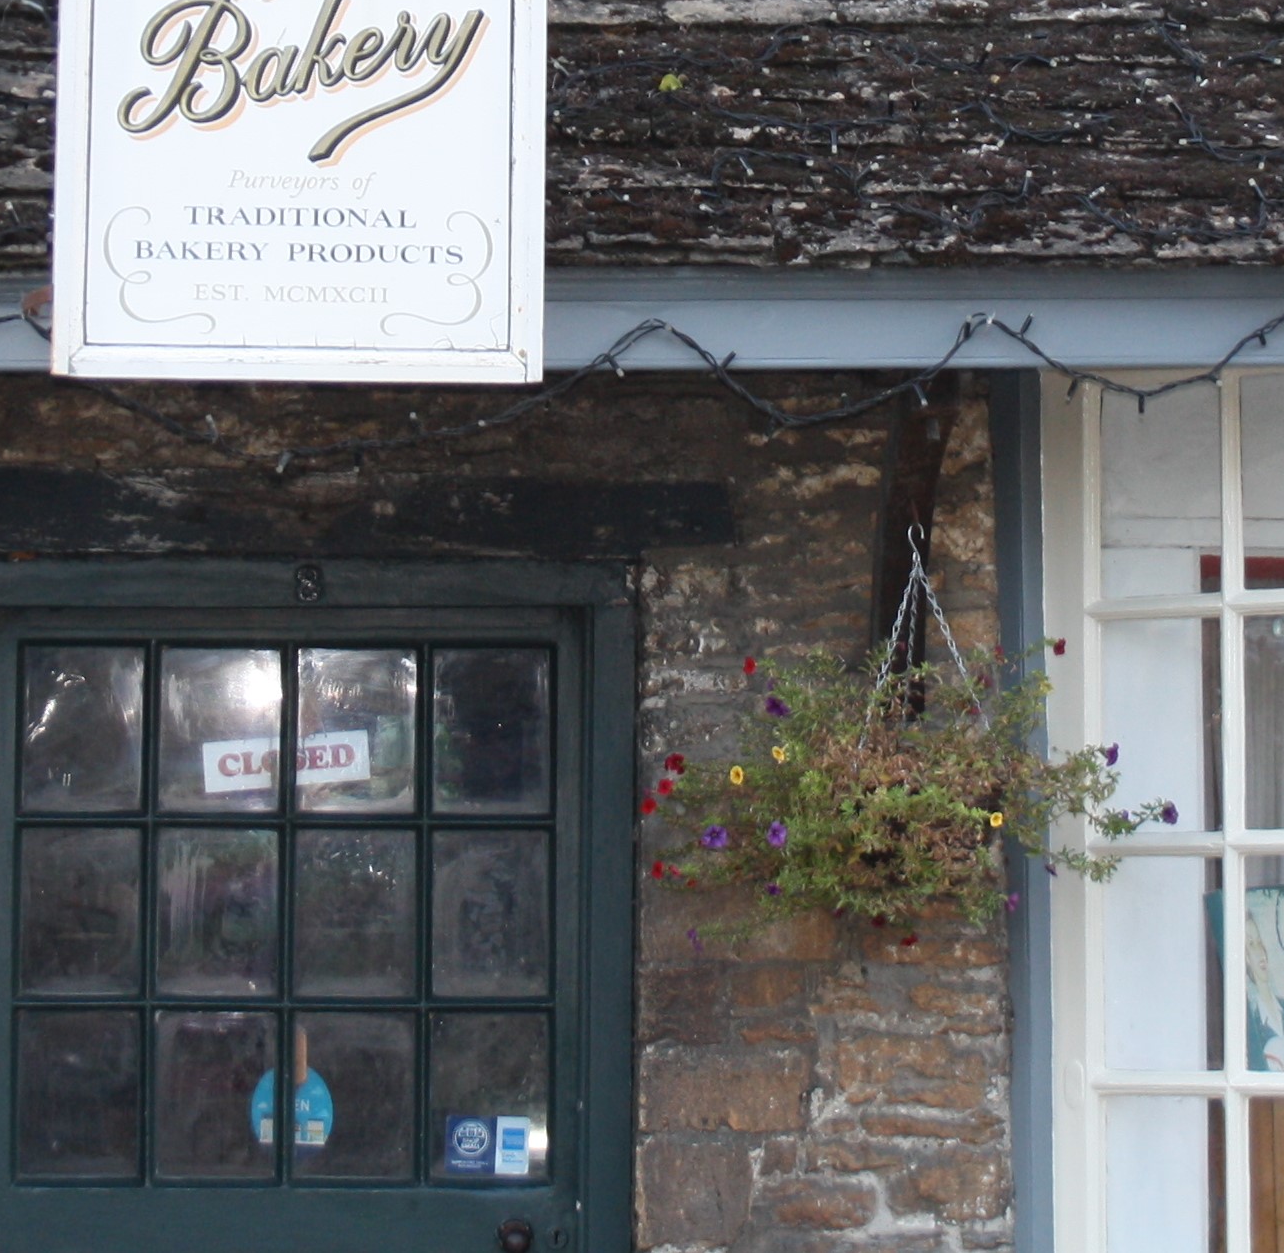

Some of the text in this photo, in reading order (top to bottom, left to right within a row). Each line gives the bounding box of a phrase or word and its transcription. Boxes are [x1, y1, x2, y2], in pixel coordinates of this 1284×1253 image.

[228, 170, 378, 198] Purveyors of
[184, 205, 417, 230] TRADITIONAL
[134, 239, 464, 265] BAKERY PRODUCTS
[192, 283, 389, 304] EST. MCMXCII
